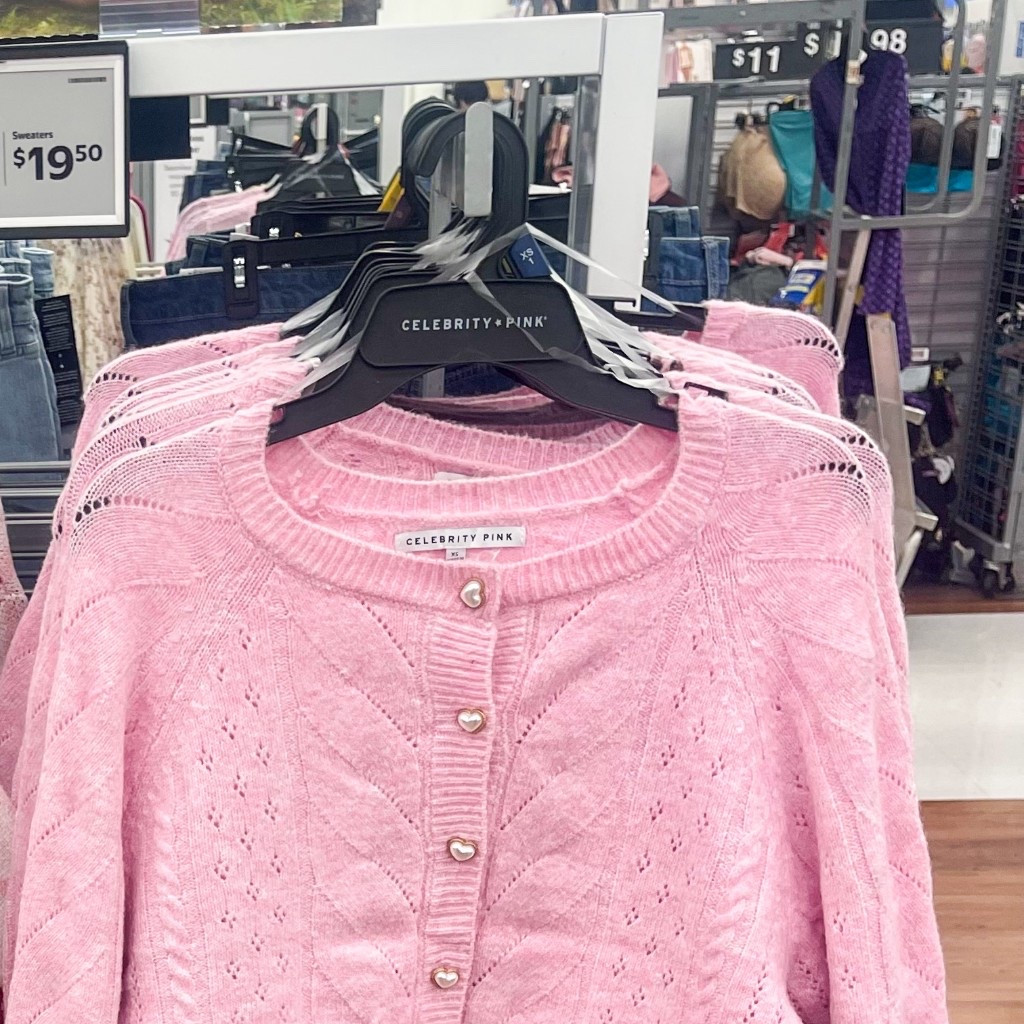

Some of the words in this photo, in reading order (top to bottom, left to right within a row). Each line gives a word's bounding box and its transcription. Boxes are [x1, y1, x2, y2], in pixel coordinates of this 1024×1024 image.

[732, 46, 780, 74] $11
[12, 130, 54, 140] Sweaters
[519, 247, 534, 260] XS
[401, 317, 493, 332] CELEBRITY
[505, 315, 546, 329] PINK
[406, 534, 477, 546] CELEBRITY
[483, 532, 513, 542] PINK
